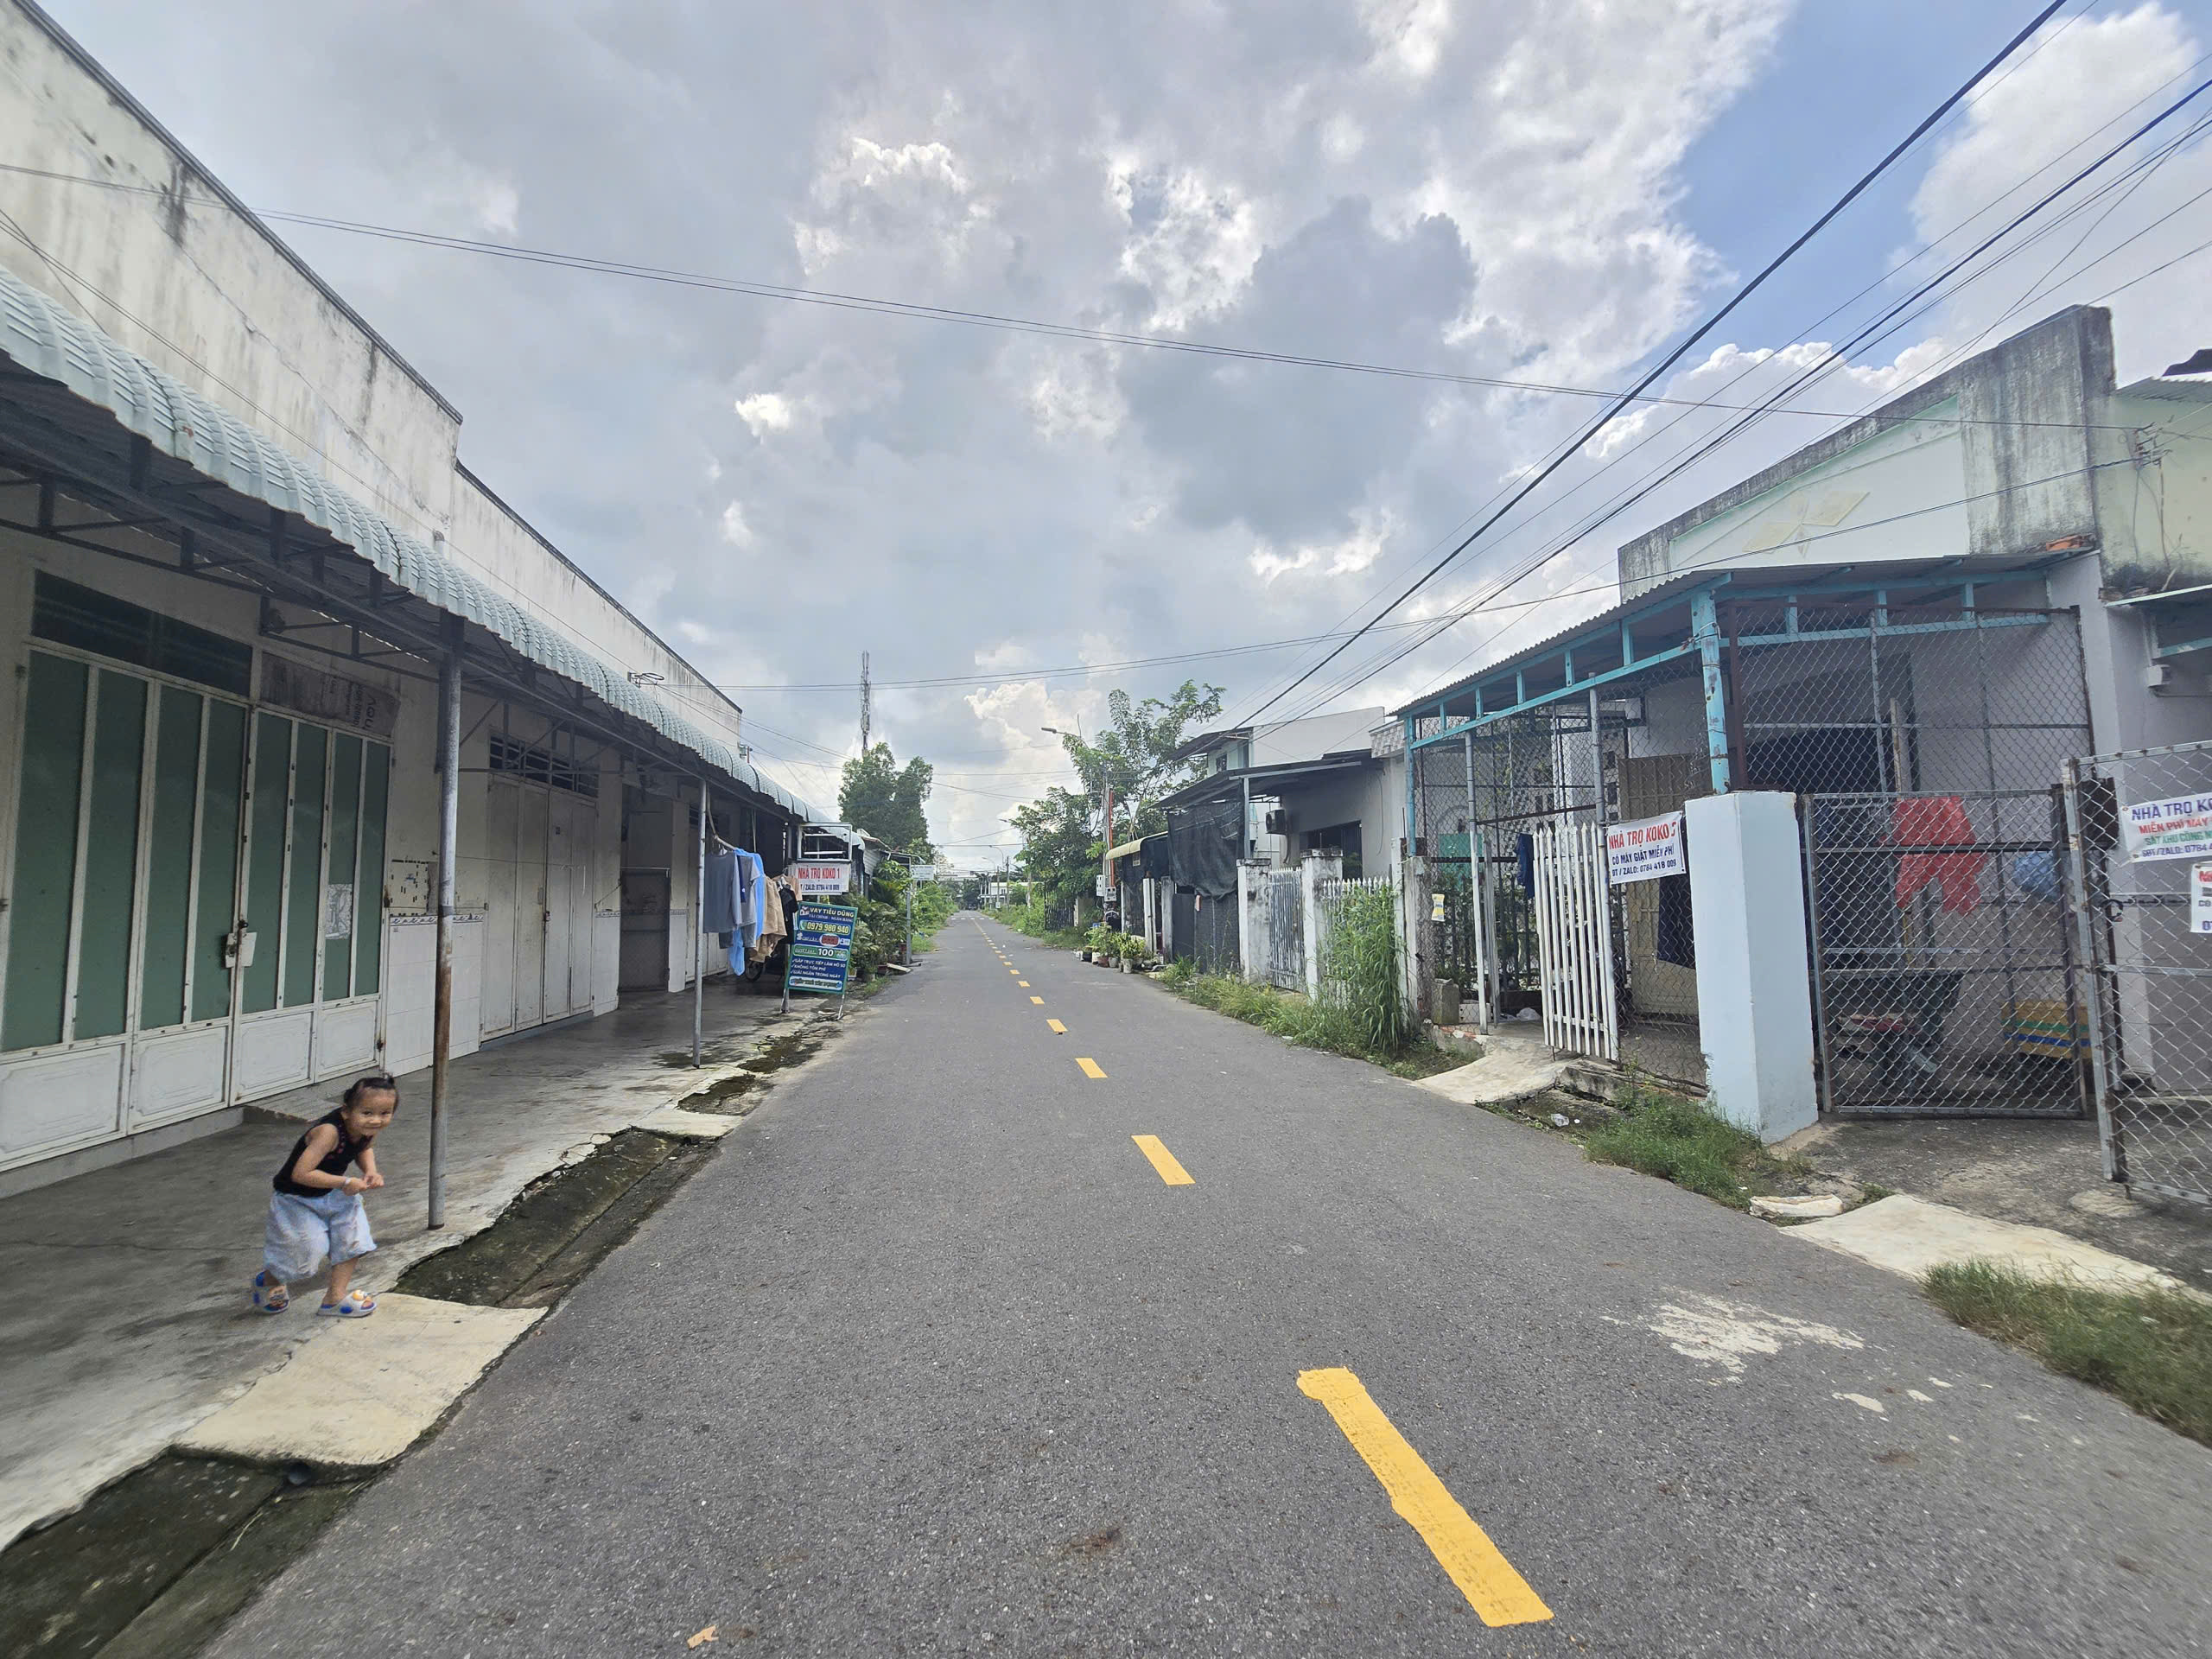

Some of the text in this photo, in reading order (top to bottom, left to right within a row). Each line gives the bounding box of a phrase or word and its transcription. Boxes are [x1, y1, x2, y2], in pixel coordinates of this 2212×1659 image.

[362, 694, 376, 730] AQU
[2132, 804, 2161, 821] NHÀ
[2164, 802, 2192, 817] TRỌ
[2139, 822, 2164, 834] MIỄN
[2166, 819, 2184, 830] PHÍ
[1609, 830, 1624, 849] NHÀ
[1627, 830, 1643, 847] TRỌ
[1646, 823, 1669, 842] KOKO
[1611, 854, 1619, 865] CÓ
[1620, 853, 1632, 864] MÁY
[1633, 849, 1648, 862] GIẶT
[798, 865, 840, 881] NHÀ TRỌ KOKO 1
[1623, 866, 1638, 874] ZALO:
[1654, 861, 1665, 869] 418
[807, 922, 823, 931] 0979
[837, 925, 849, 934] 940
[818, 948, 834, 957] 100
